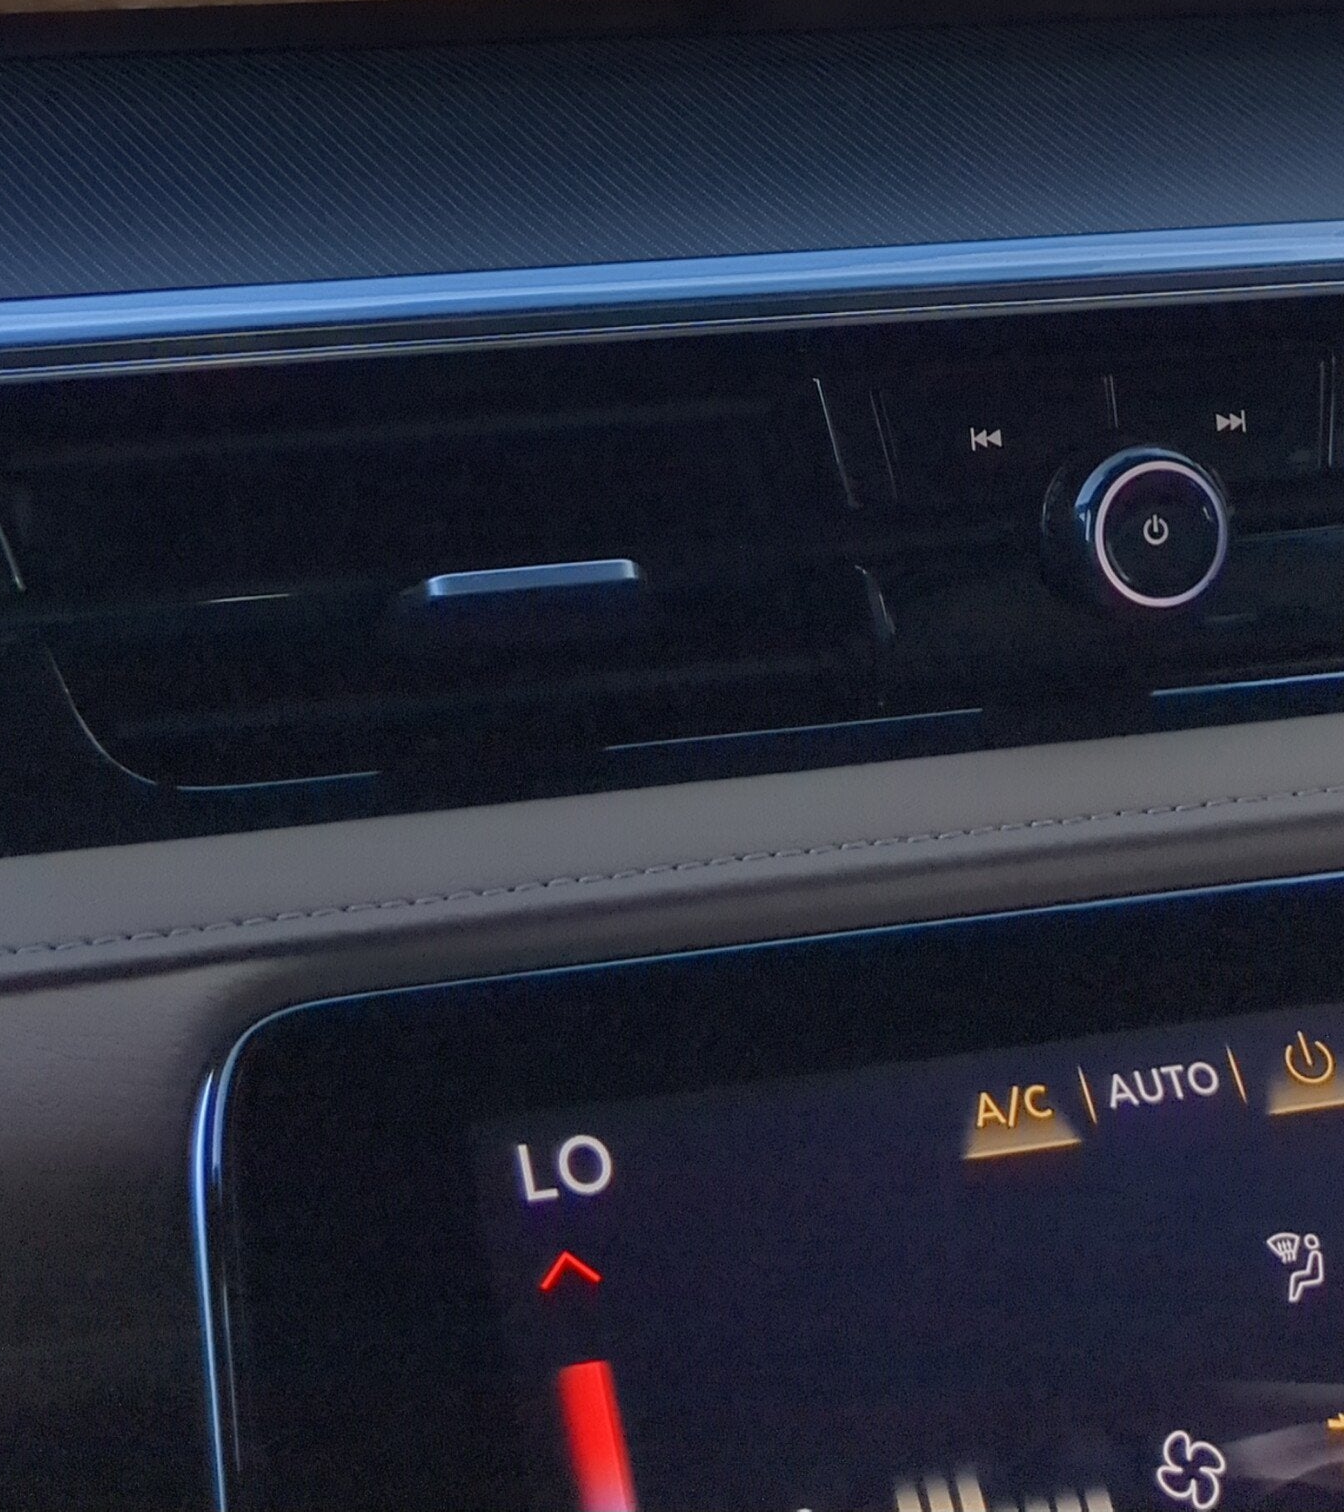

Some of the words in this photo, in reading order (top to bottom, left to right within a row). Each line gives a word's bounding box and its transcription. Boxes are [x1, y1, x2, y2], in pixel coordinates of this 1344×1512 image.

[975, 1082, 1054, 1128] A/C
[1108, 1060, 1220, 1109] AUTO
[515, 1133, 614, 1204] LO
